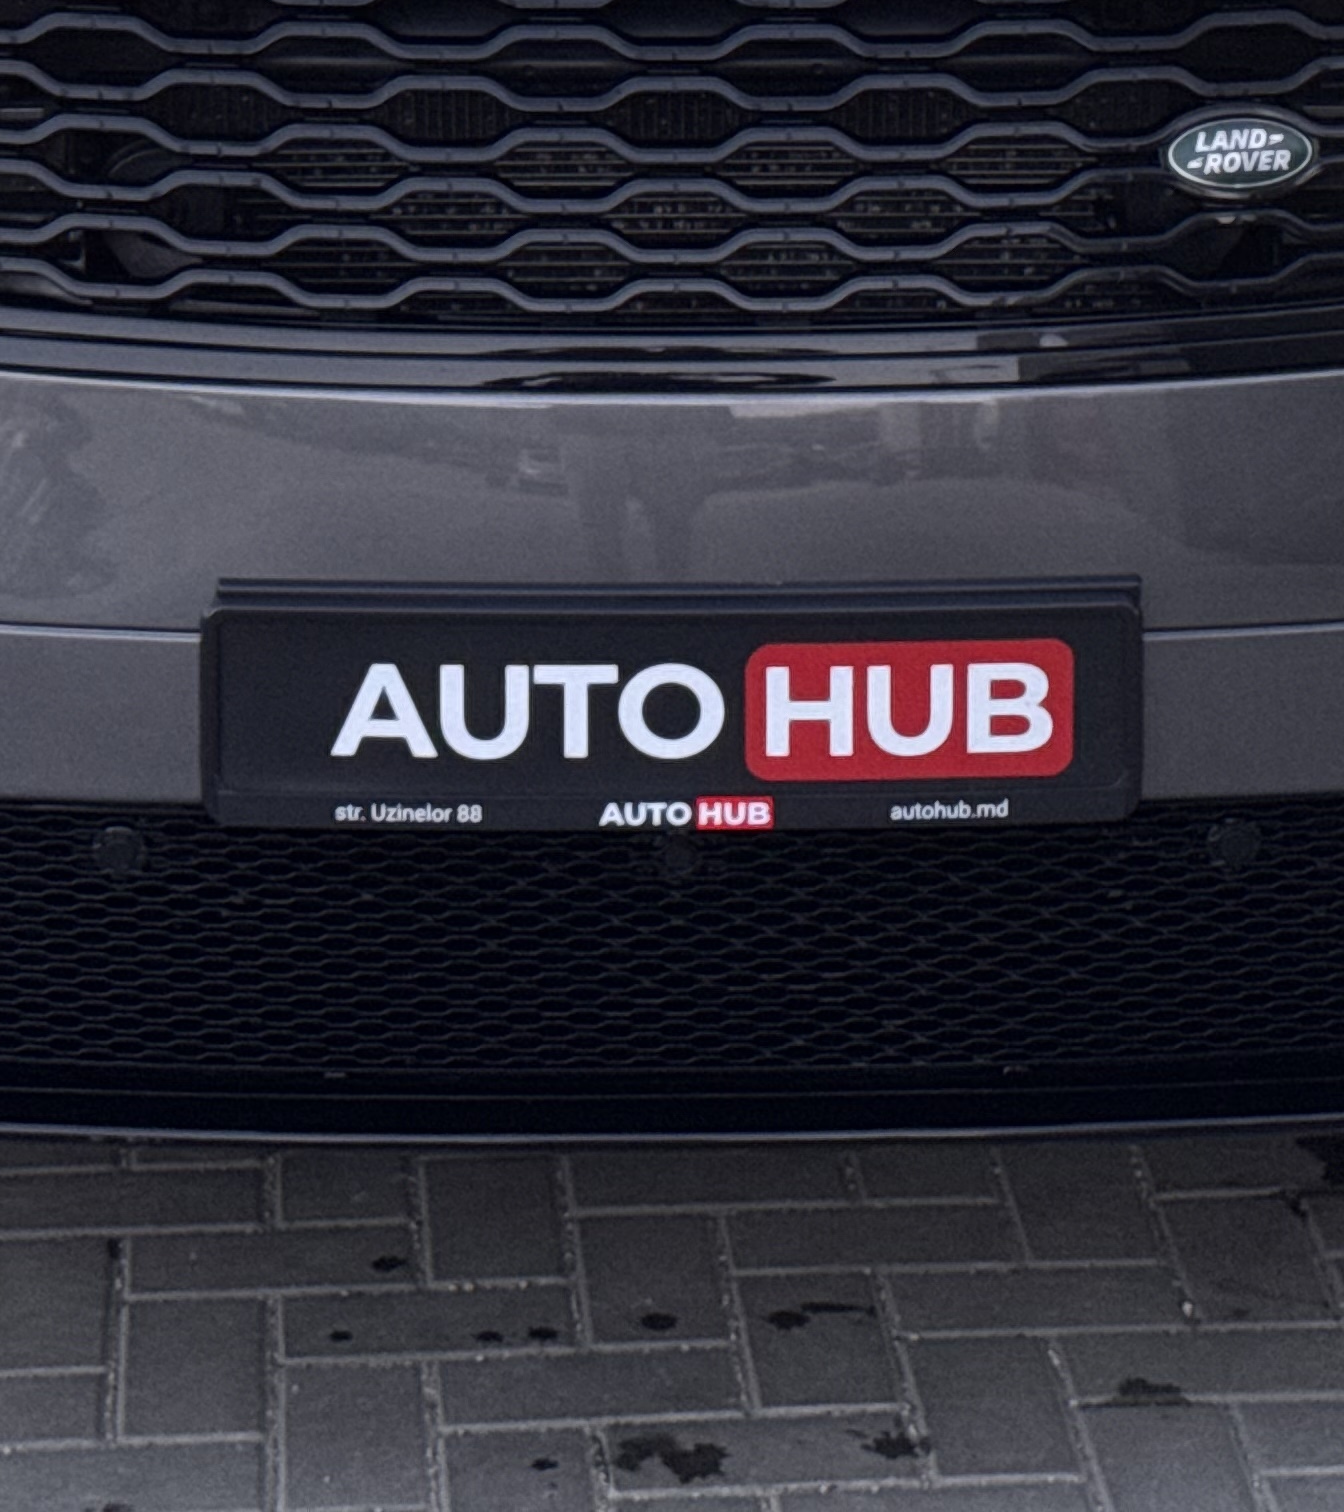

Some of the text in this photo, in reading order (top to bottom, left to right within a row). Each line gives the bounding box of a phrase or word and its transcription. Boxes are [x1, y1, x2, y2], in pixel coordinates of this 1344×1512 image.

[1194, 128, 1268, 153] LAND
[1203, 149, 1292, 175] ROVER
[330, 661, 1054, 761] AUTO HUB
[334, 802, 483, 824] str. Uzinelor 88
[598, 801, 771, 827] AUTO HUB
[889, 798, 1010, 821] autohub.md
